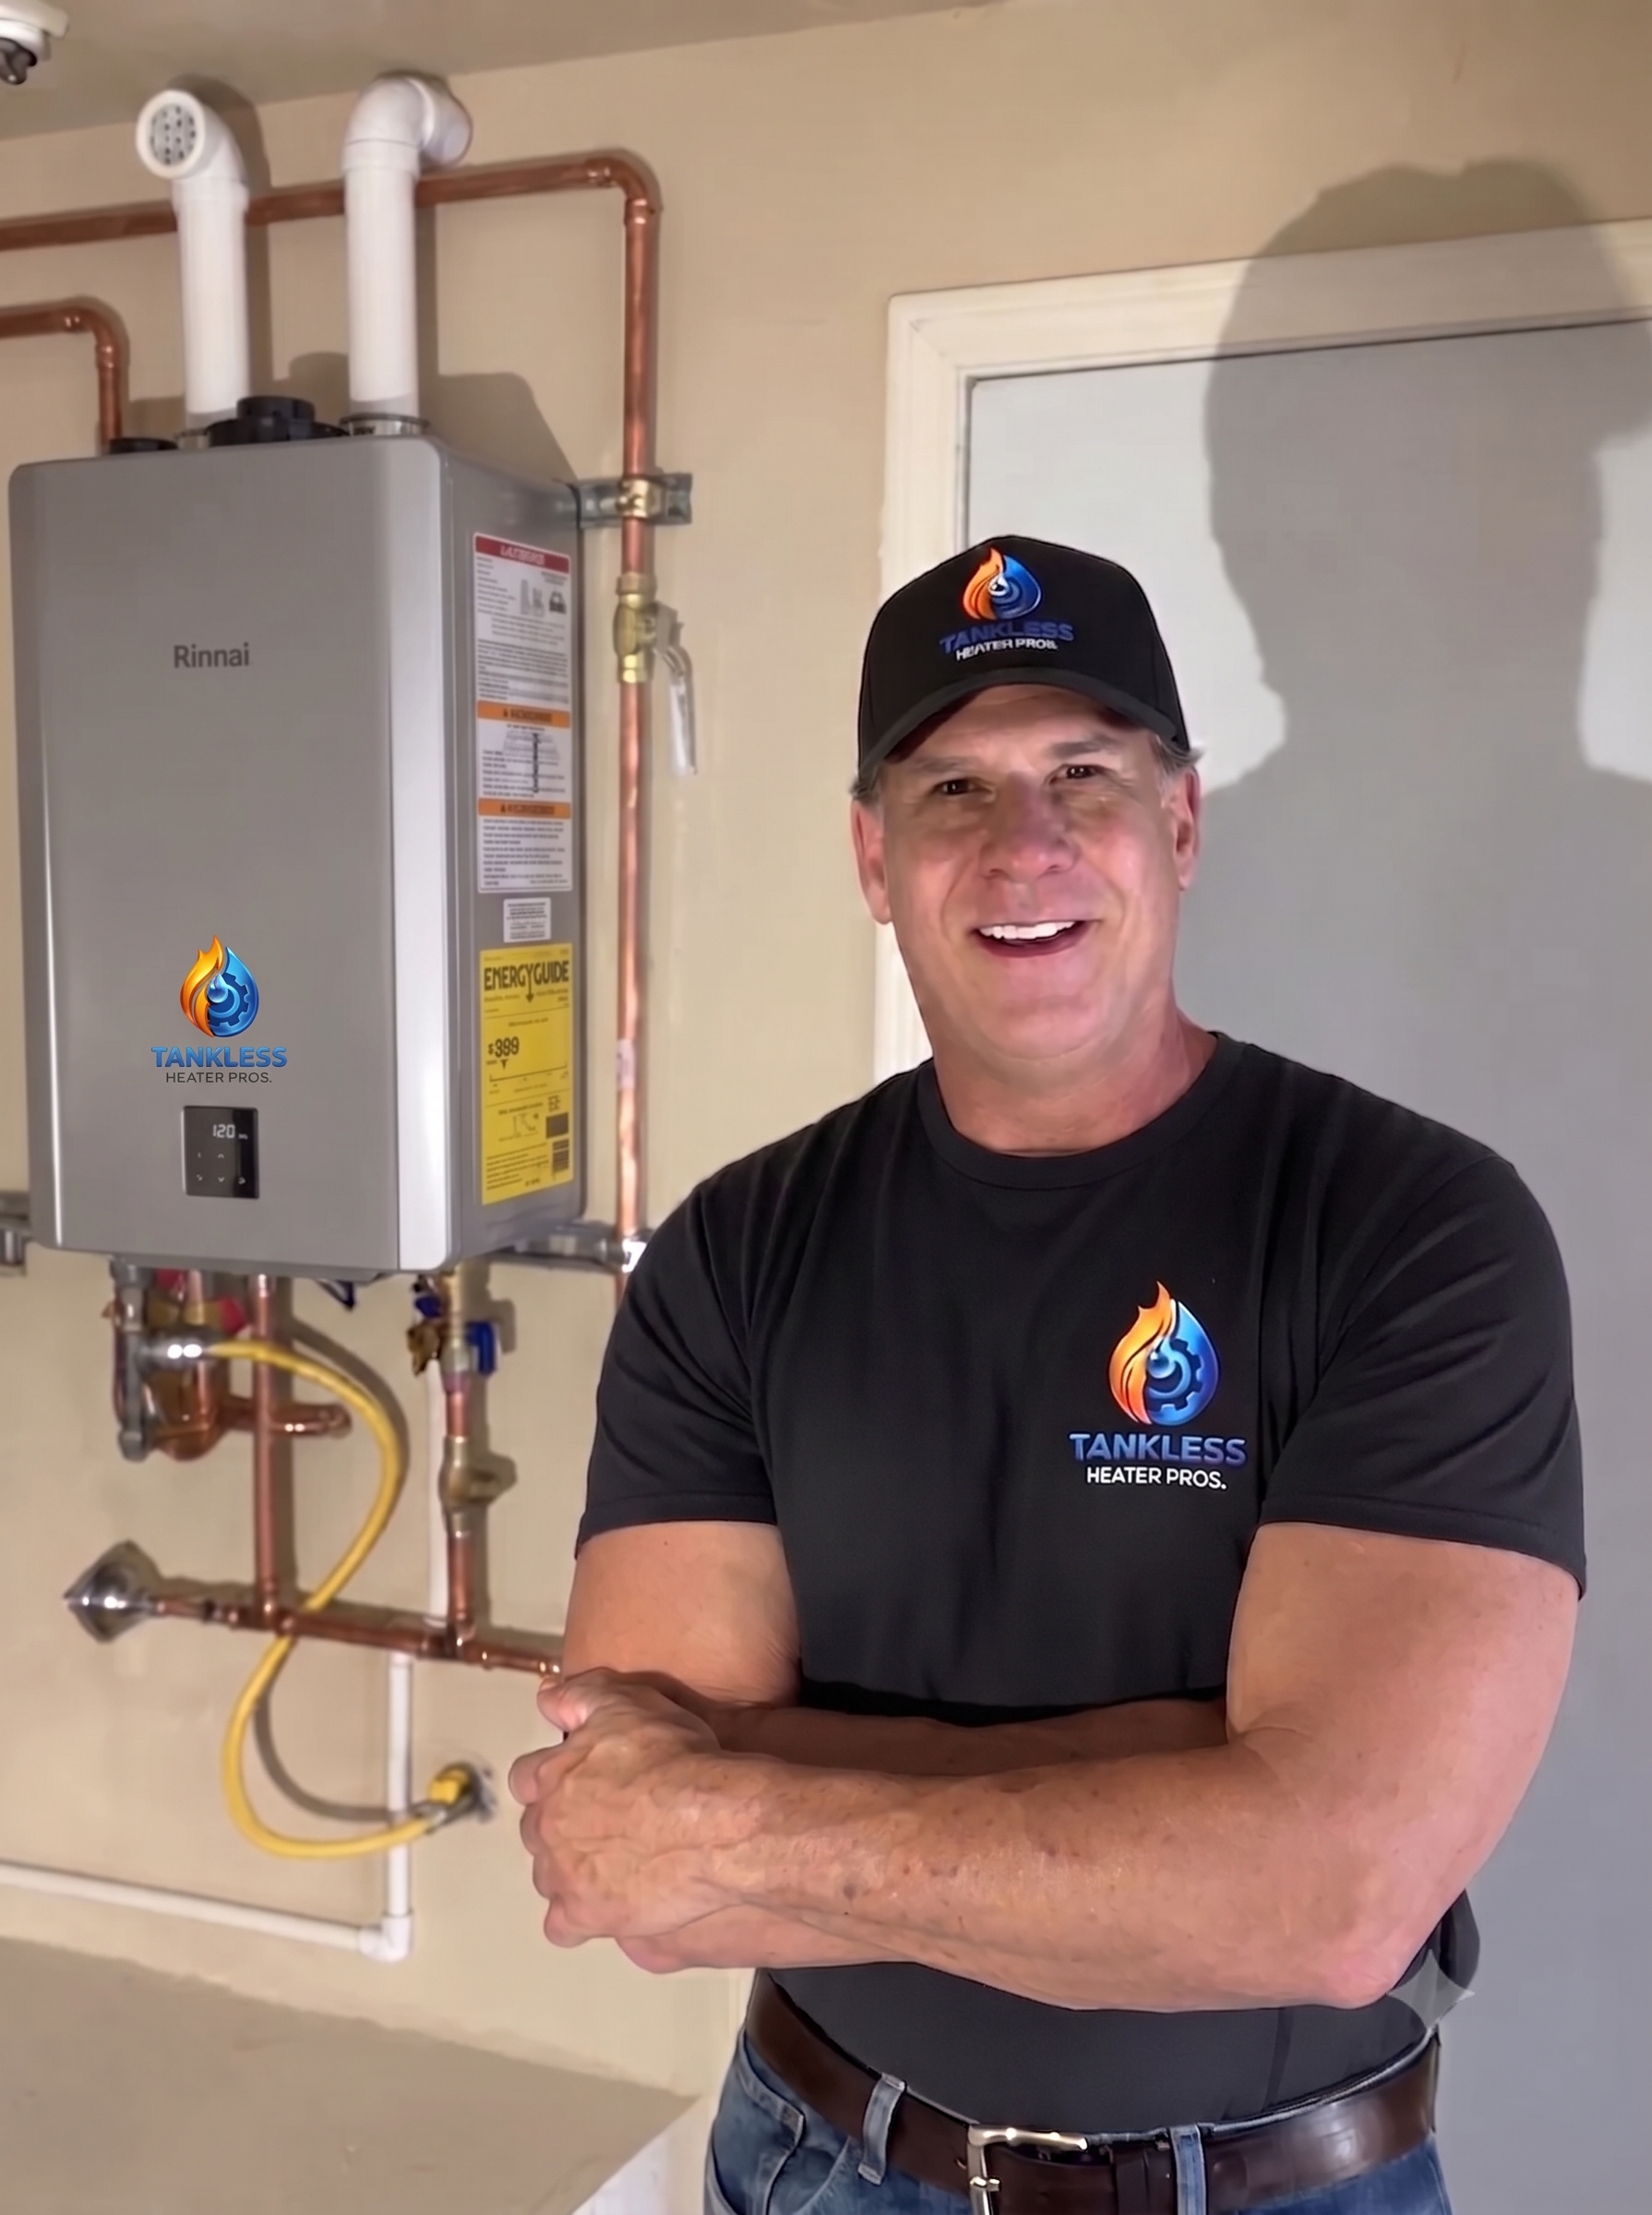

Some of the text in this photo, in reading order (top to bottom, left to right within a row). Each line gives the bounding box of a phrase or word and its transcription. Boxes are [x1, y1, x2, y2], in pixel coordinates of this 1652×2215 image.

[940, 620, 1074, 653] TANKLESS
[174, 641, 249, 668] Rinnai
[956, 638, 1013, 661] HEATER
[484, 960, 569, 991] ENERGYGUIDE
[151, 1046, 288, 1067] TANKLESS
[165, 1072, 272, 1083] HEATER PROS.
[212, 1123, 235, 1139] 120
[1069, 1433, 1247, 1466] TANKLESS
[1086, 1467, 1227, 1490] HEATER PROS.
